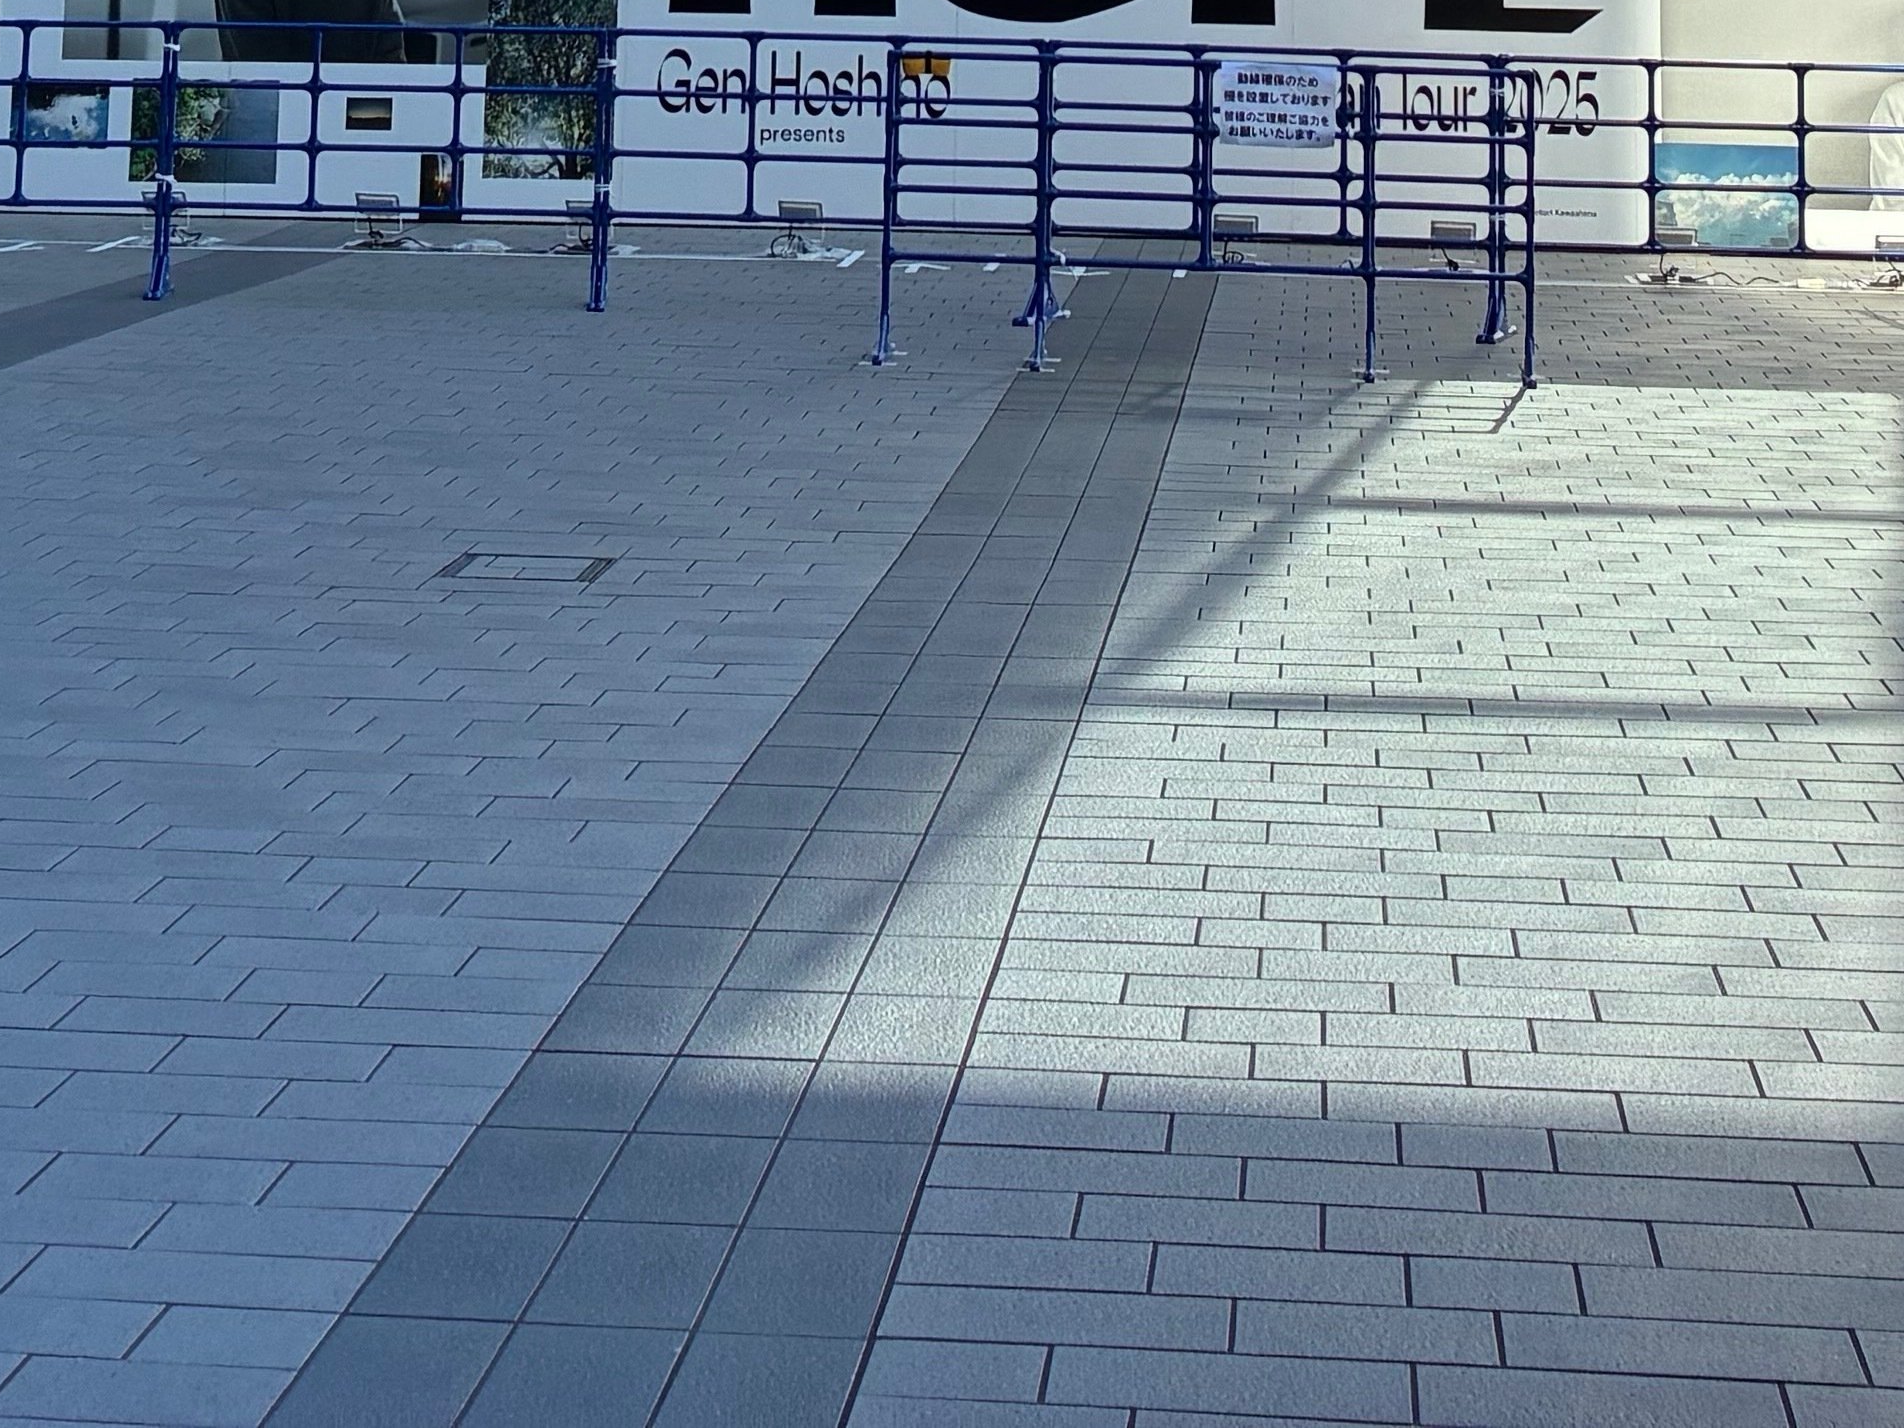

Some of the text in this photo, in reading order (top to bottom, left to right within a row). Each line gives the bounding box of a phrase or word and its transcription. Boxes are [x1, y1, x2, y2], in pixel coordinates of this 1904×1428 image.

[656, 47, 952, 119] Gen Hoshno
[759, 125, 846, 146] presents
